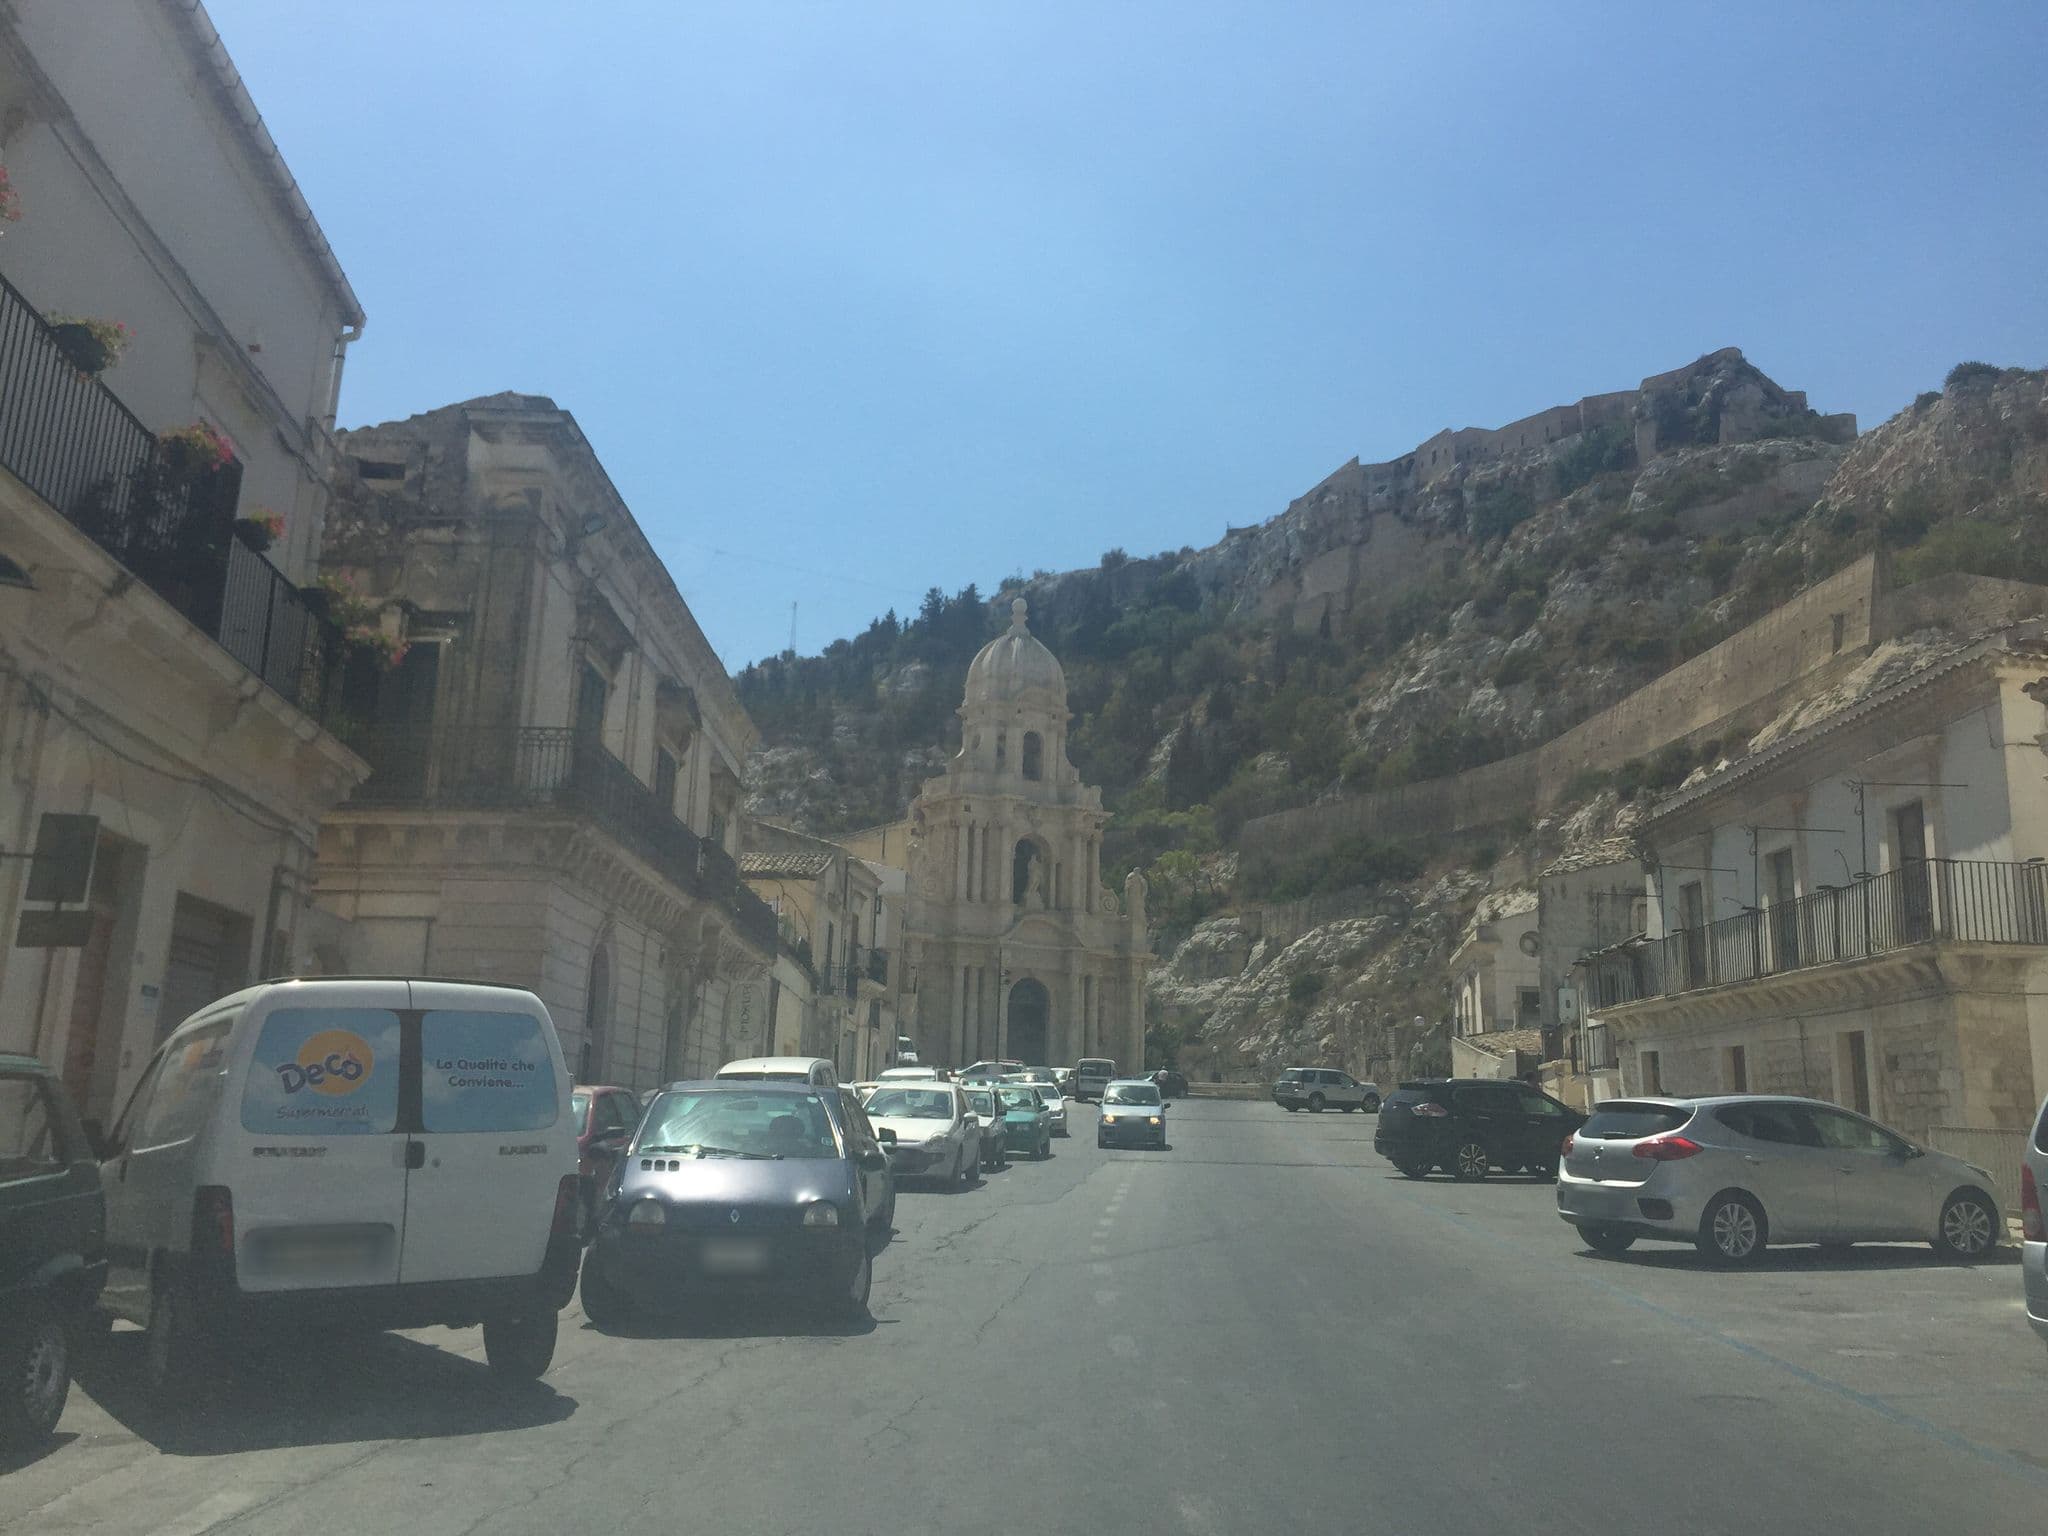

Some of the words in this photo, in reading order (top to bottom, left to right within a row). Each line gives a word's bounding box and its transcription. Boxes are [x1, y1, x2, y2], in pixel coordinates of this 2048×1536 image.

[436, 1058, 453, 1070] La
[457, 1058, 508, 1072] Qualità
[511, 1058, 536, 1071] che
